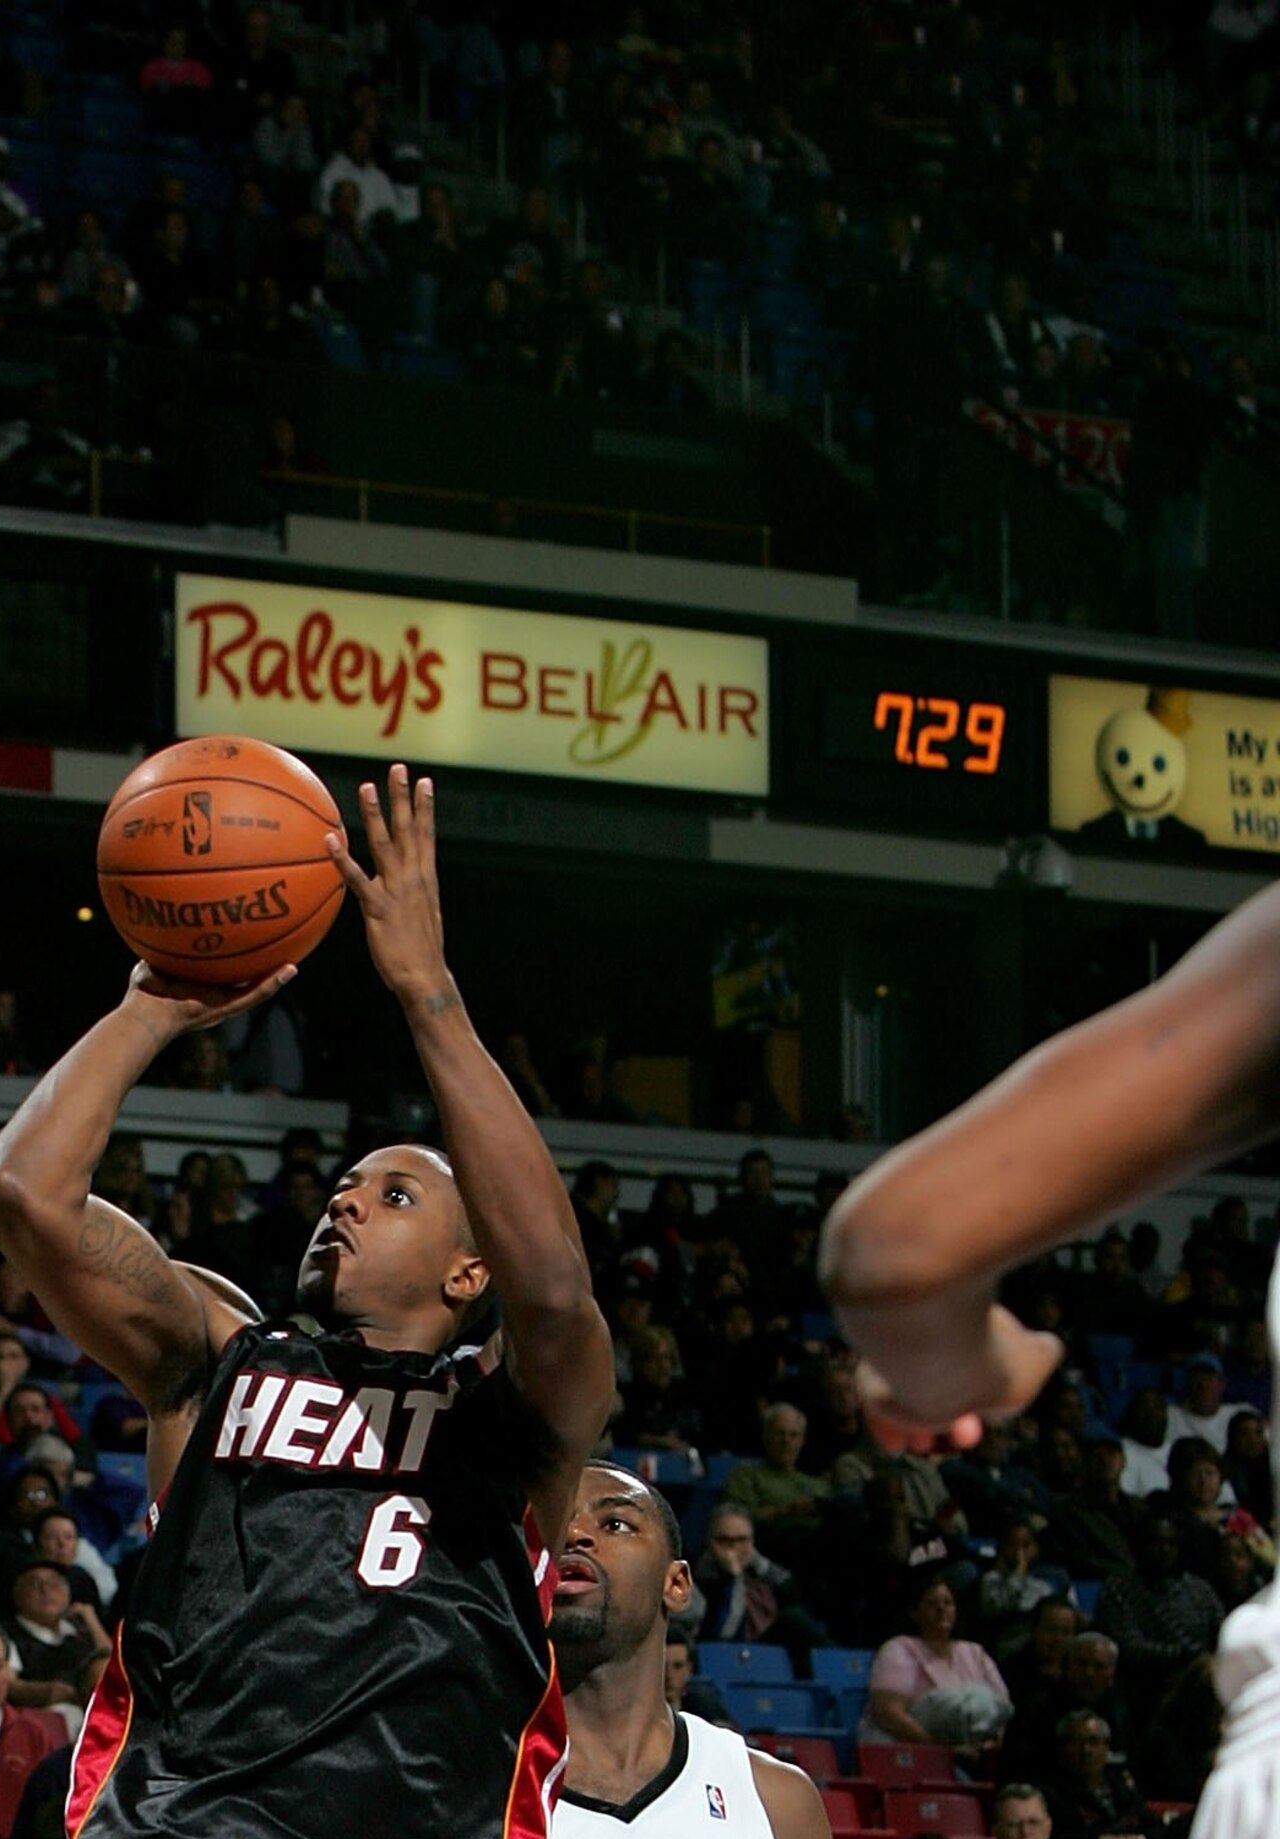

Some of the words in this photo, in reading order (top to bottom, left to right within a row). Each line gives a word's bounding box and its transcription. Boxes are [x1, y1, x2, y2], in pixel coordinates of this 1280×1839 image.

[186, 602, 444, 737] Raley's
[1226, 728, 1268, 765] My
[1229, 771, 1252, 797] is
[1261, 777, 1280, 798] a
[121, 879, 290, 928] SPALDING
[214, 1373, 460, 1472] HEAT
[357, 1494, 433, 1588] 6
